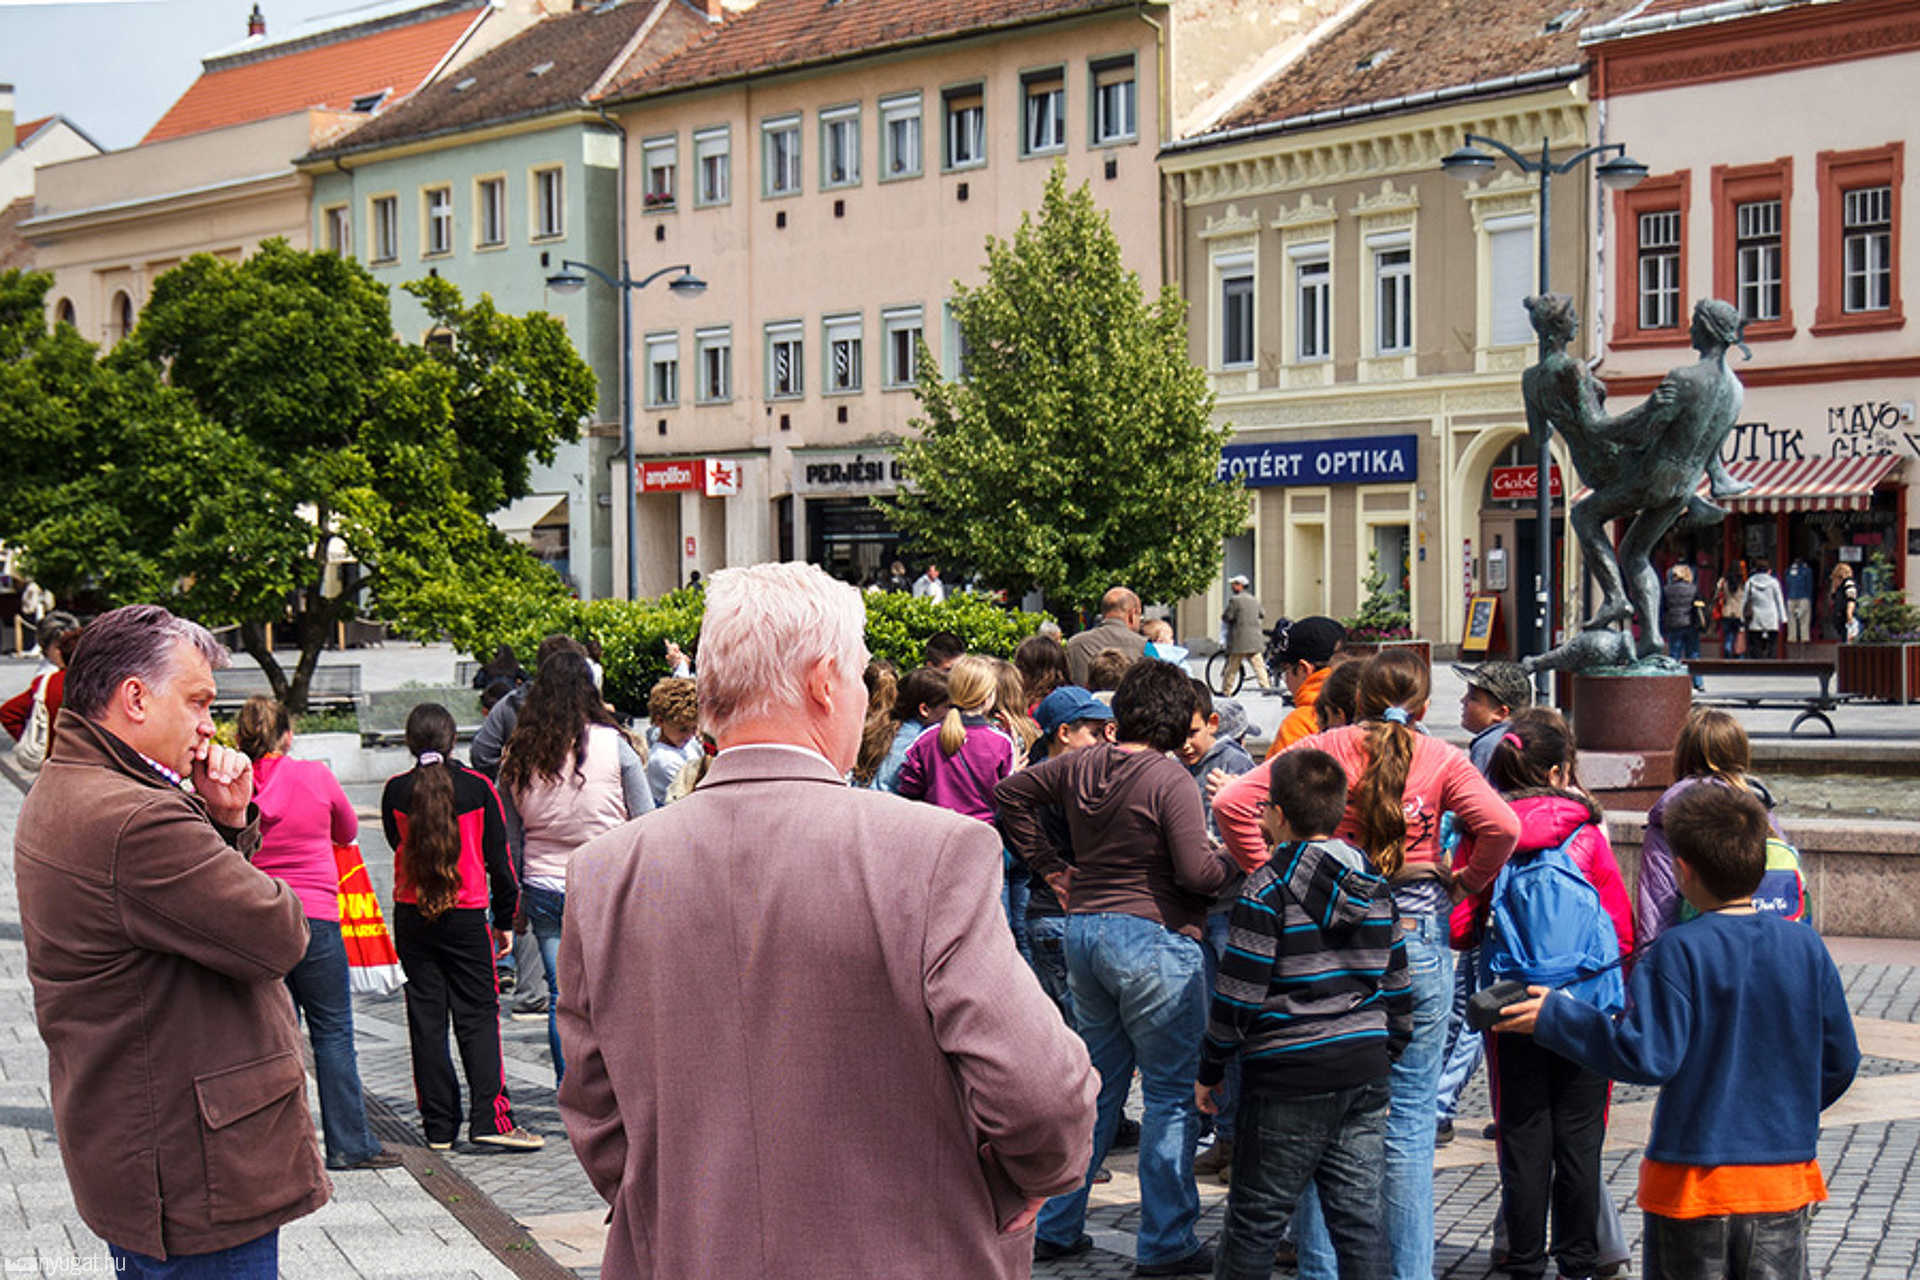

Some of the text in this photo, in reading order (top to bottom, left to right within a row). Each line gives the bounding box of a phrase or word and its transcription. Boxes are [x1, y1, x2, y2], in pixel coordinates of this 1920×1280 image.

[1827, 401, 1901, 439] MAYO
[1720, 422, 1805, 463] UTIK
[805, 453, 884, 484] PERJÉSI
[1217, 449, 1405, 480] FOTÉRT OPTIKA
